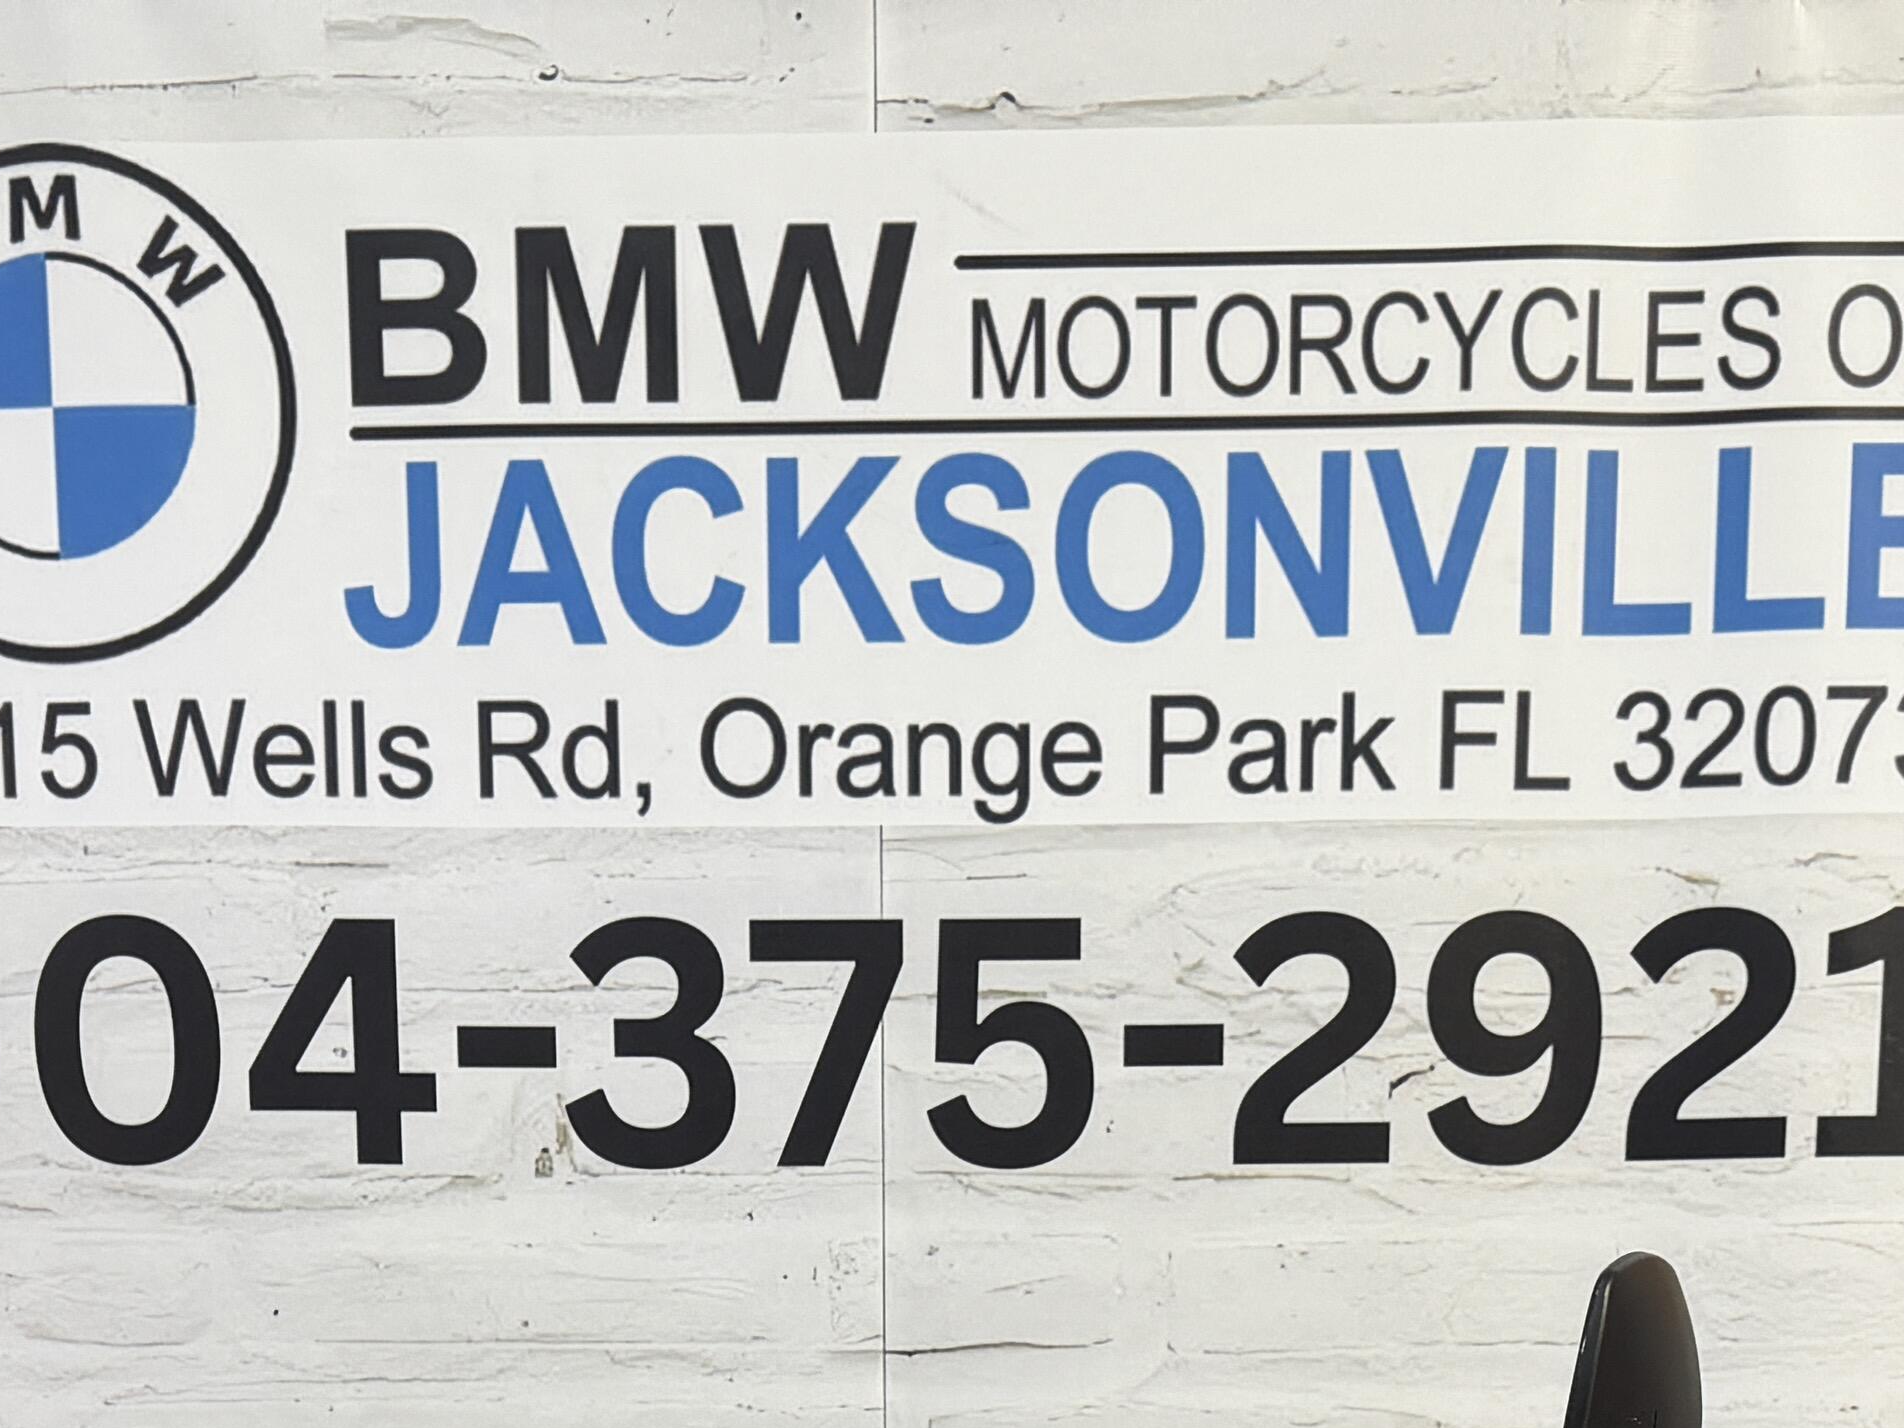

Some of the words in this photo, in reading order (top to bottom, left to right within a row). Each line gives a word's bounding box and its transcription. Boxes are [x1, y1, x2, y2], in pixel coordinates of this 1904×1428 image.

[346, 223, 917, 406] BMW
[971, 287, 1782, 400] MOTORCYCLES
[133, 699, 434, 799] Wells
[477, 699, 652, 816] Rd,
[700, 697, 1103, 824] Orange
[1150, 692, 1396, 795] Park
[1440, 690, 1571, 791] FL
